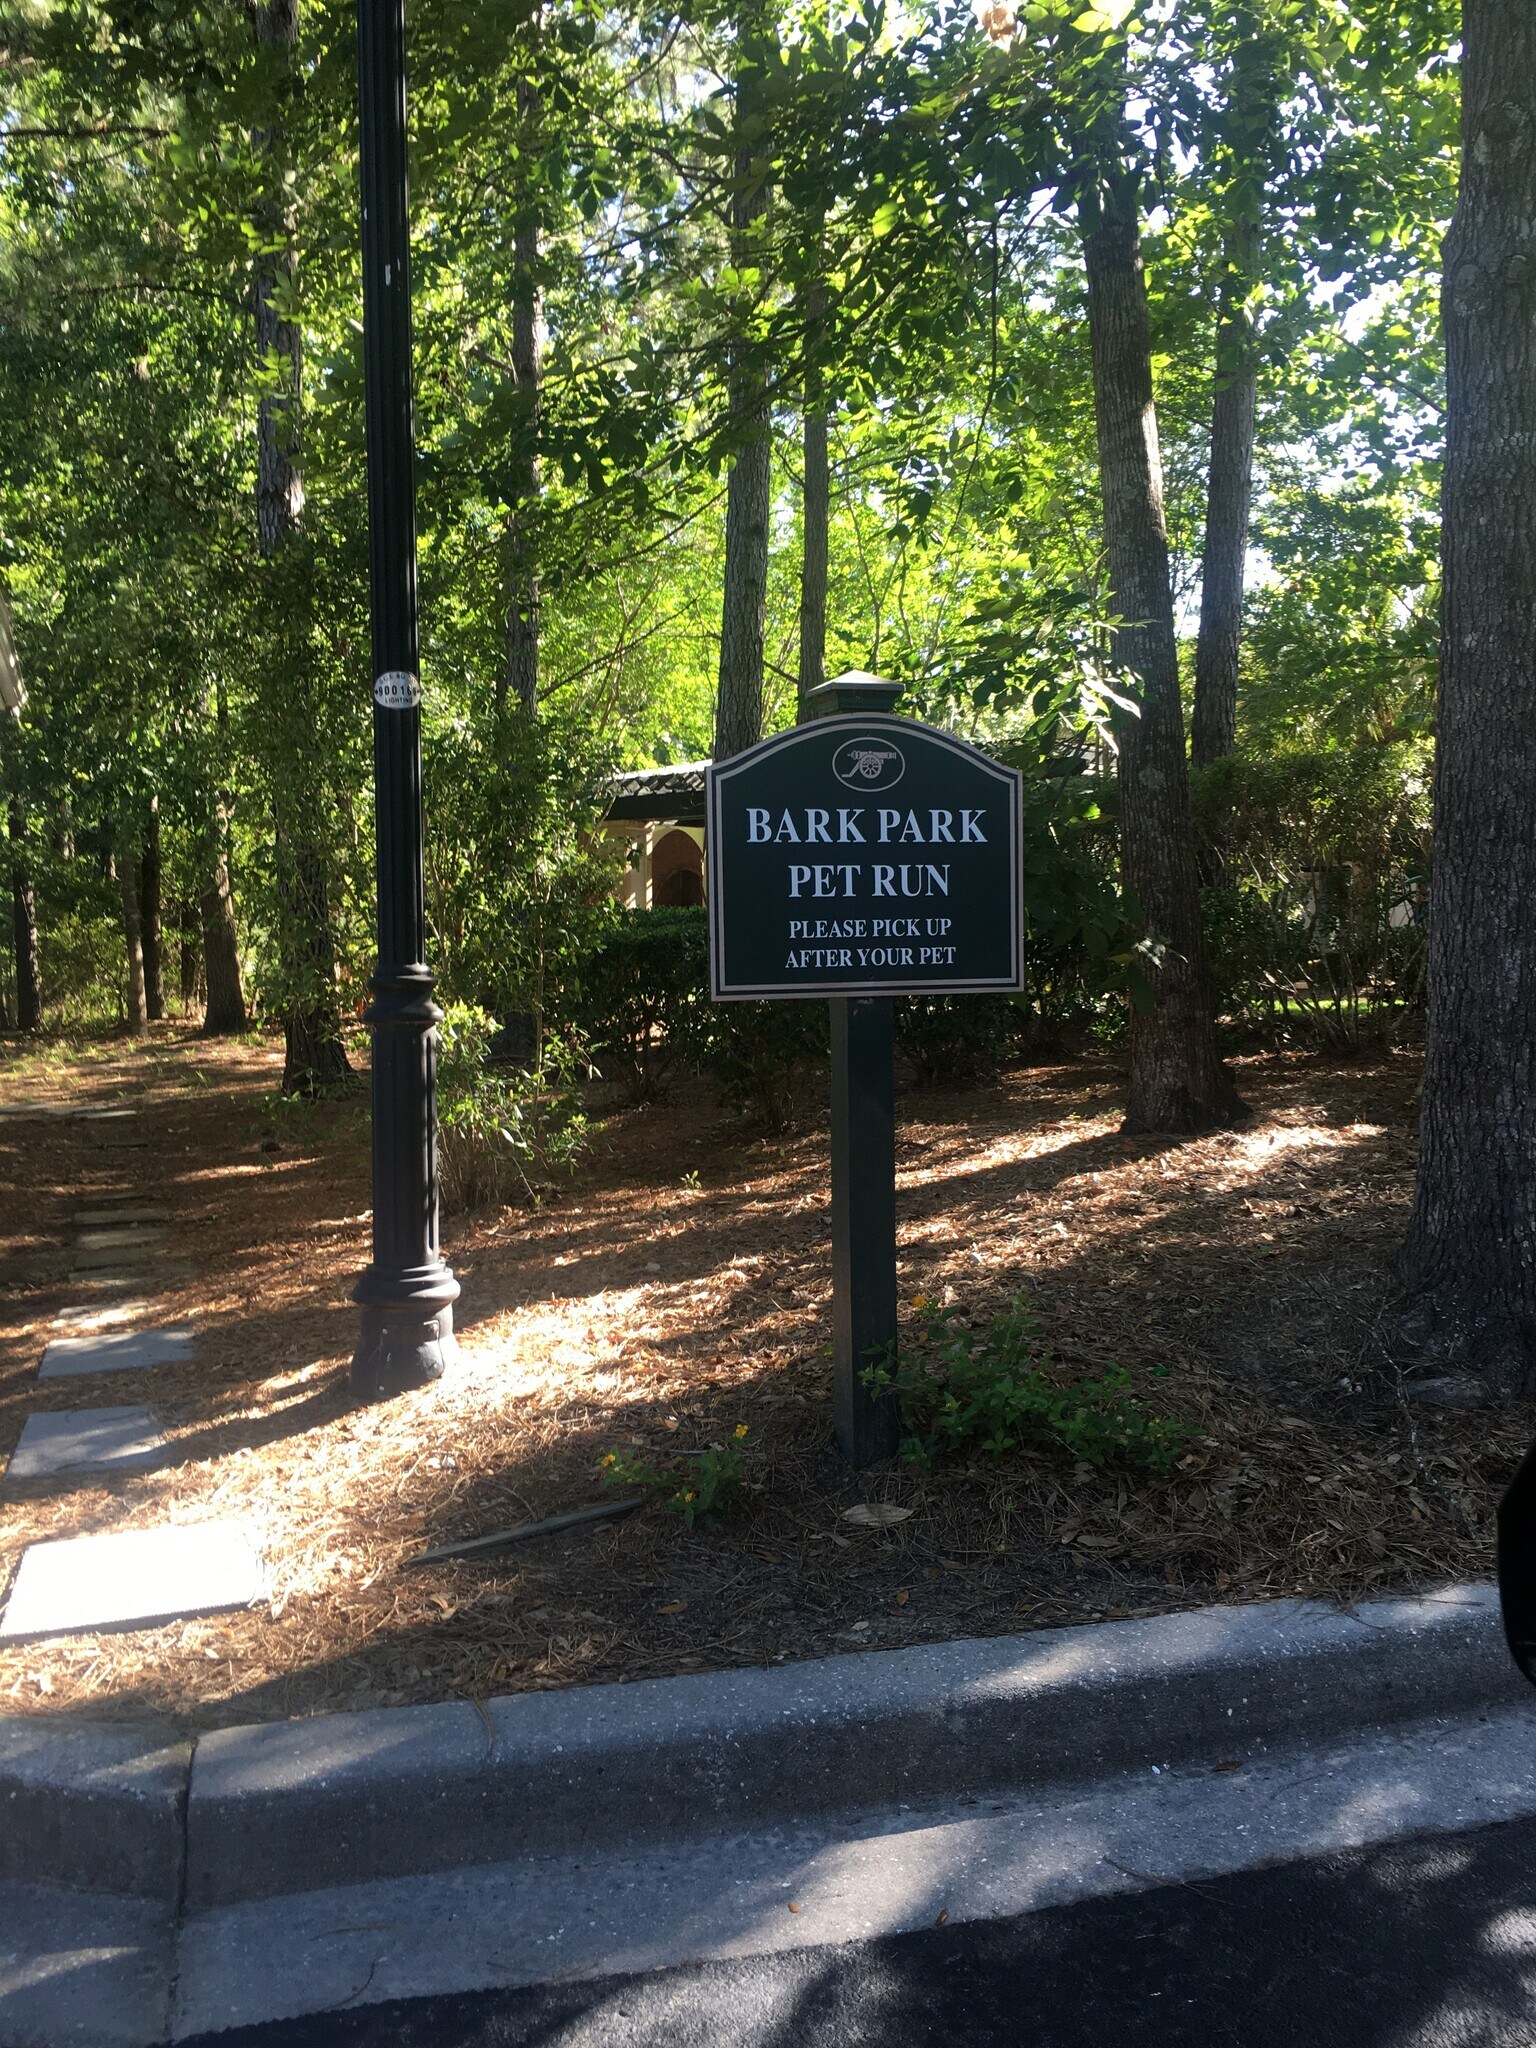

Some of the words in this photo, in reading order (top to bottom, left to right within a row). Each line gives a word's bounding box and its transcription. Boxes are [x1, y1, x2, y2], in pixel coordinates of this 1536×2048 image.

[746, 808, 867, 843] BARK
[877, 809, 988, 843] PARK
[788, 865, 861, 898] PET
[871, 864, 951, 897] RUN
[789, 919, 868, 939] PLEASE
[872, 919, 921, 937] PICK
[926, 918, 953, 936] UP
[785, 949, 853, 968] AFTER
[857, 948, 914, 966] YOUR
[919, 947, 957, 965] PET
